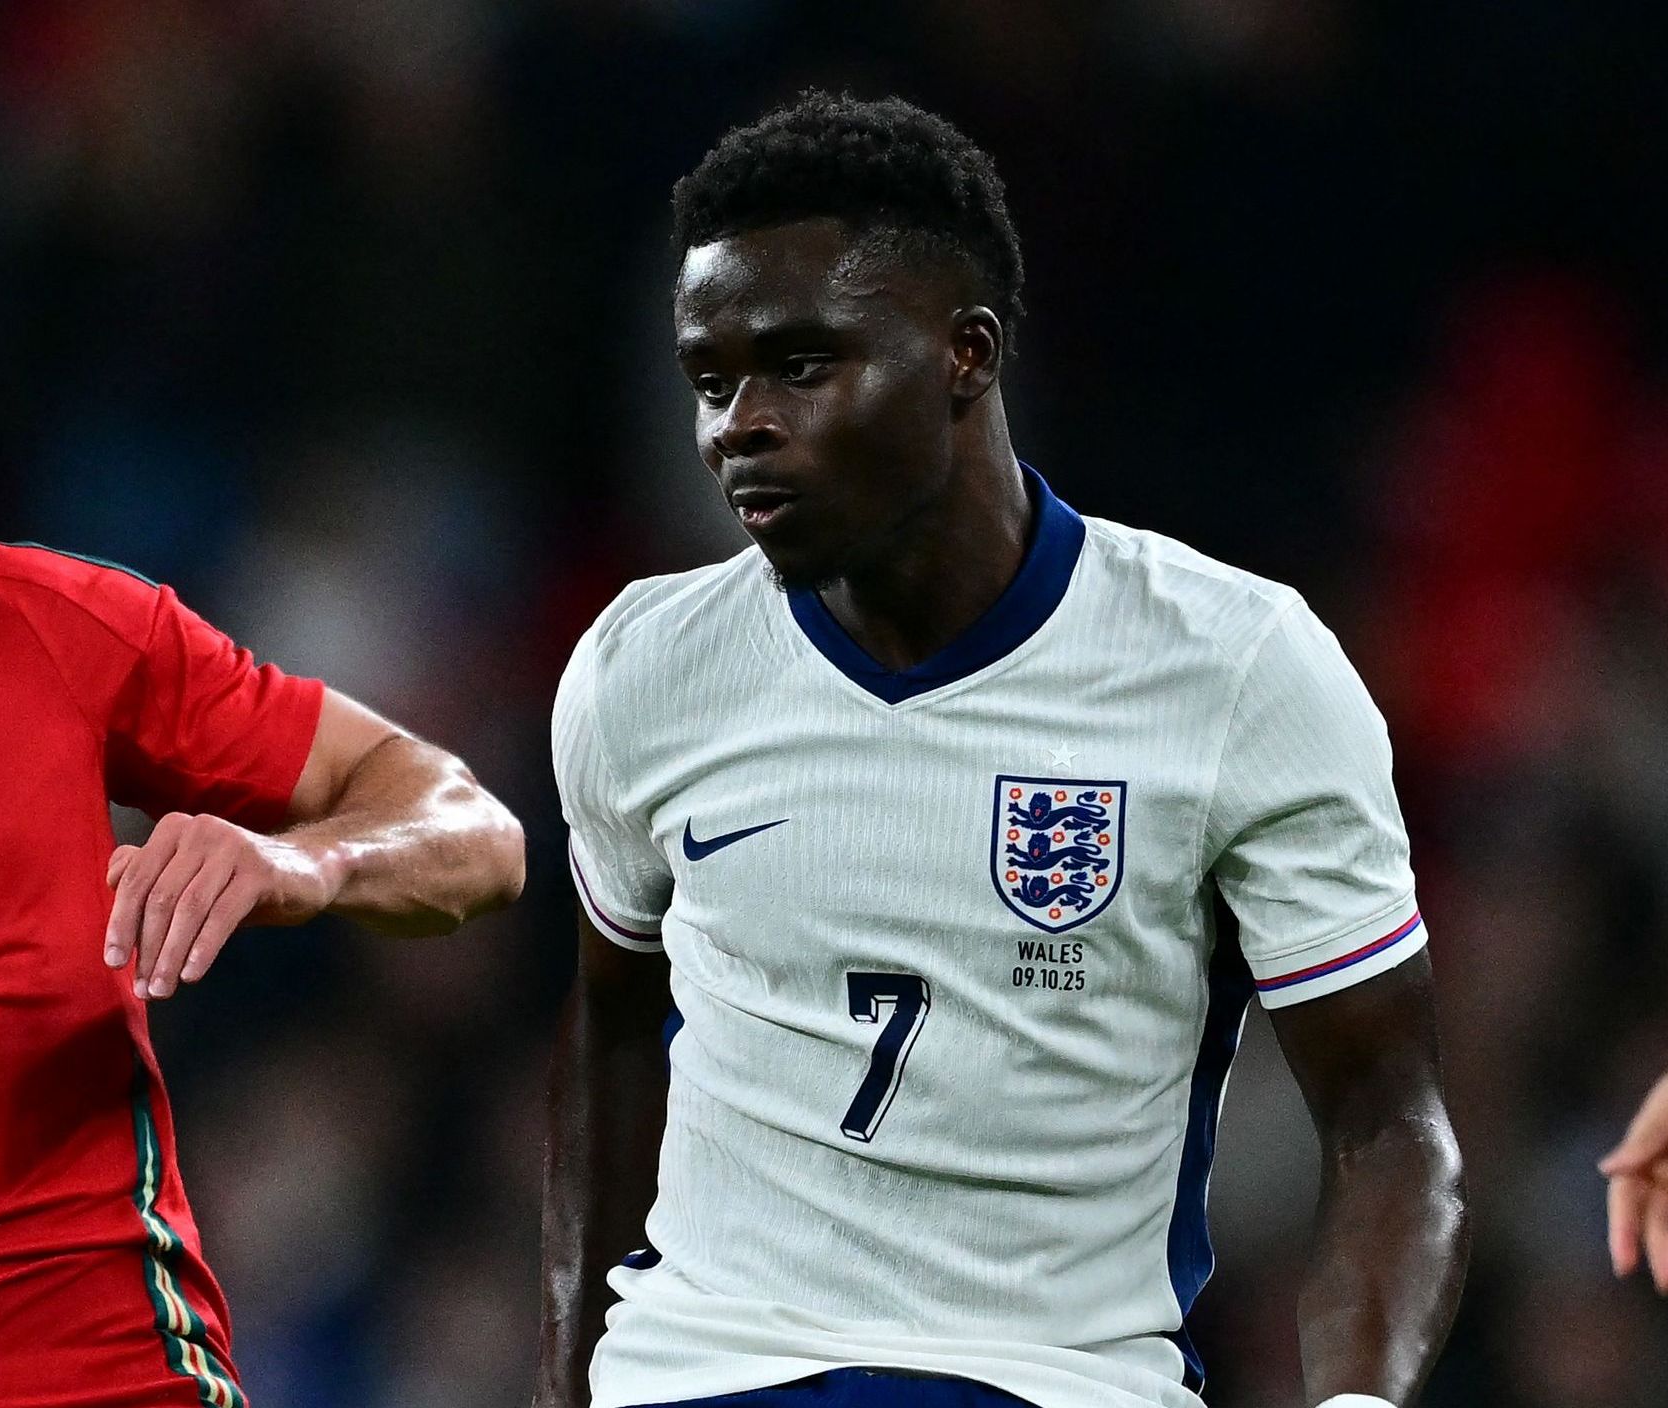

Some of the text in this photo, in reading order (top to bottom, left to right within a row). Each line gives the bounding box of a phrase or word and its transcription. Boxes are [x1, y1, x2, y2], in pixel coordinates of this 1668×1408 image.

[1018, 941, 1083, 963] WALES
[1012, 967, 1085, 990] 09.10.25
[840, 972, 931, 1143] 7
